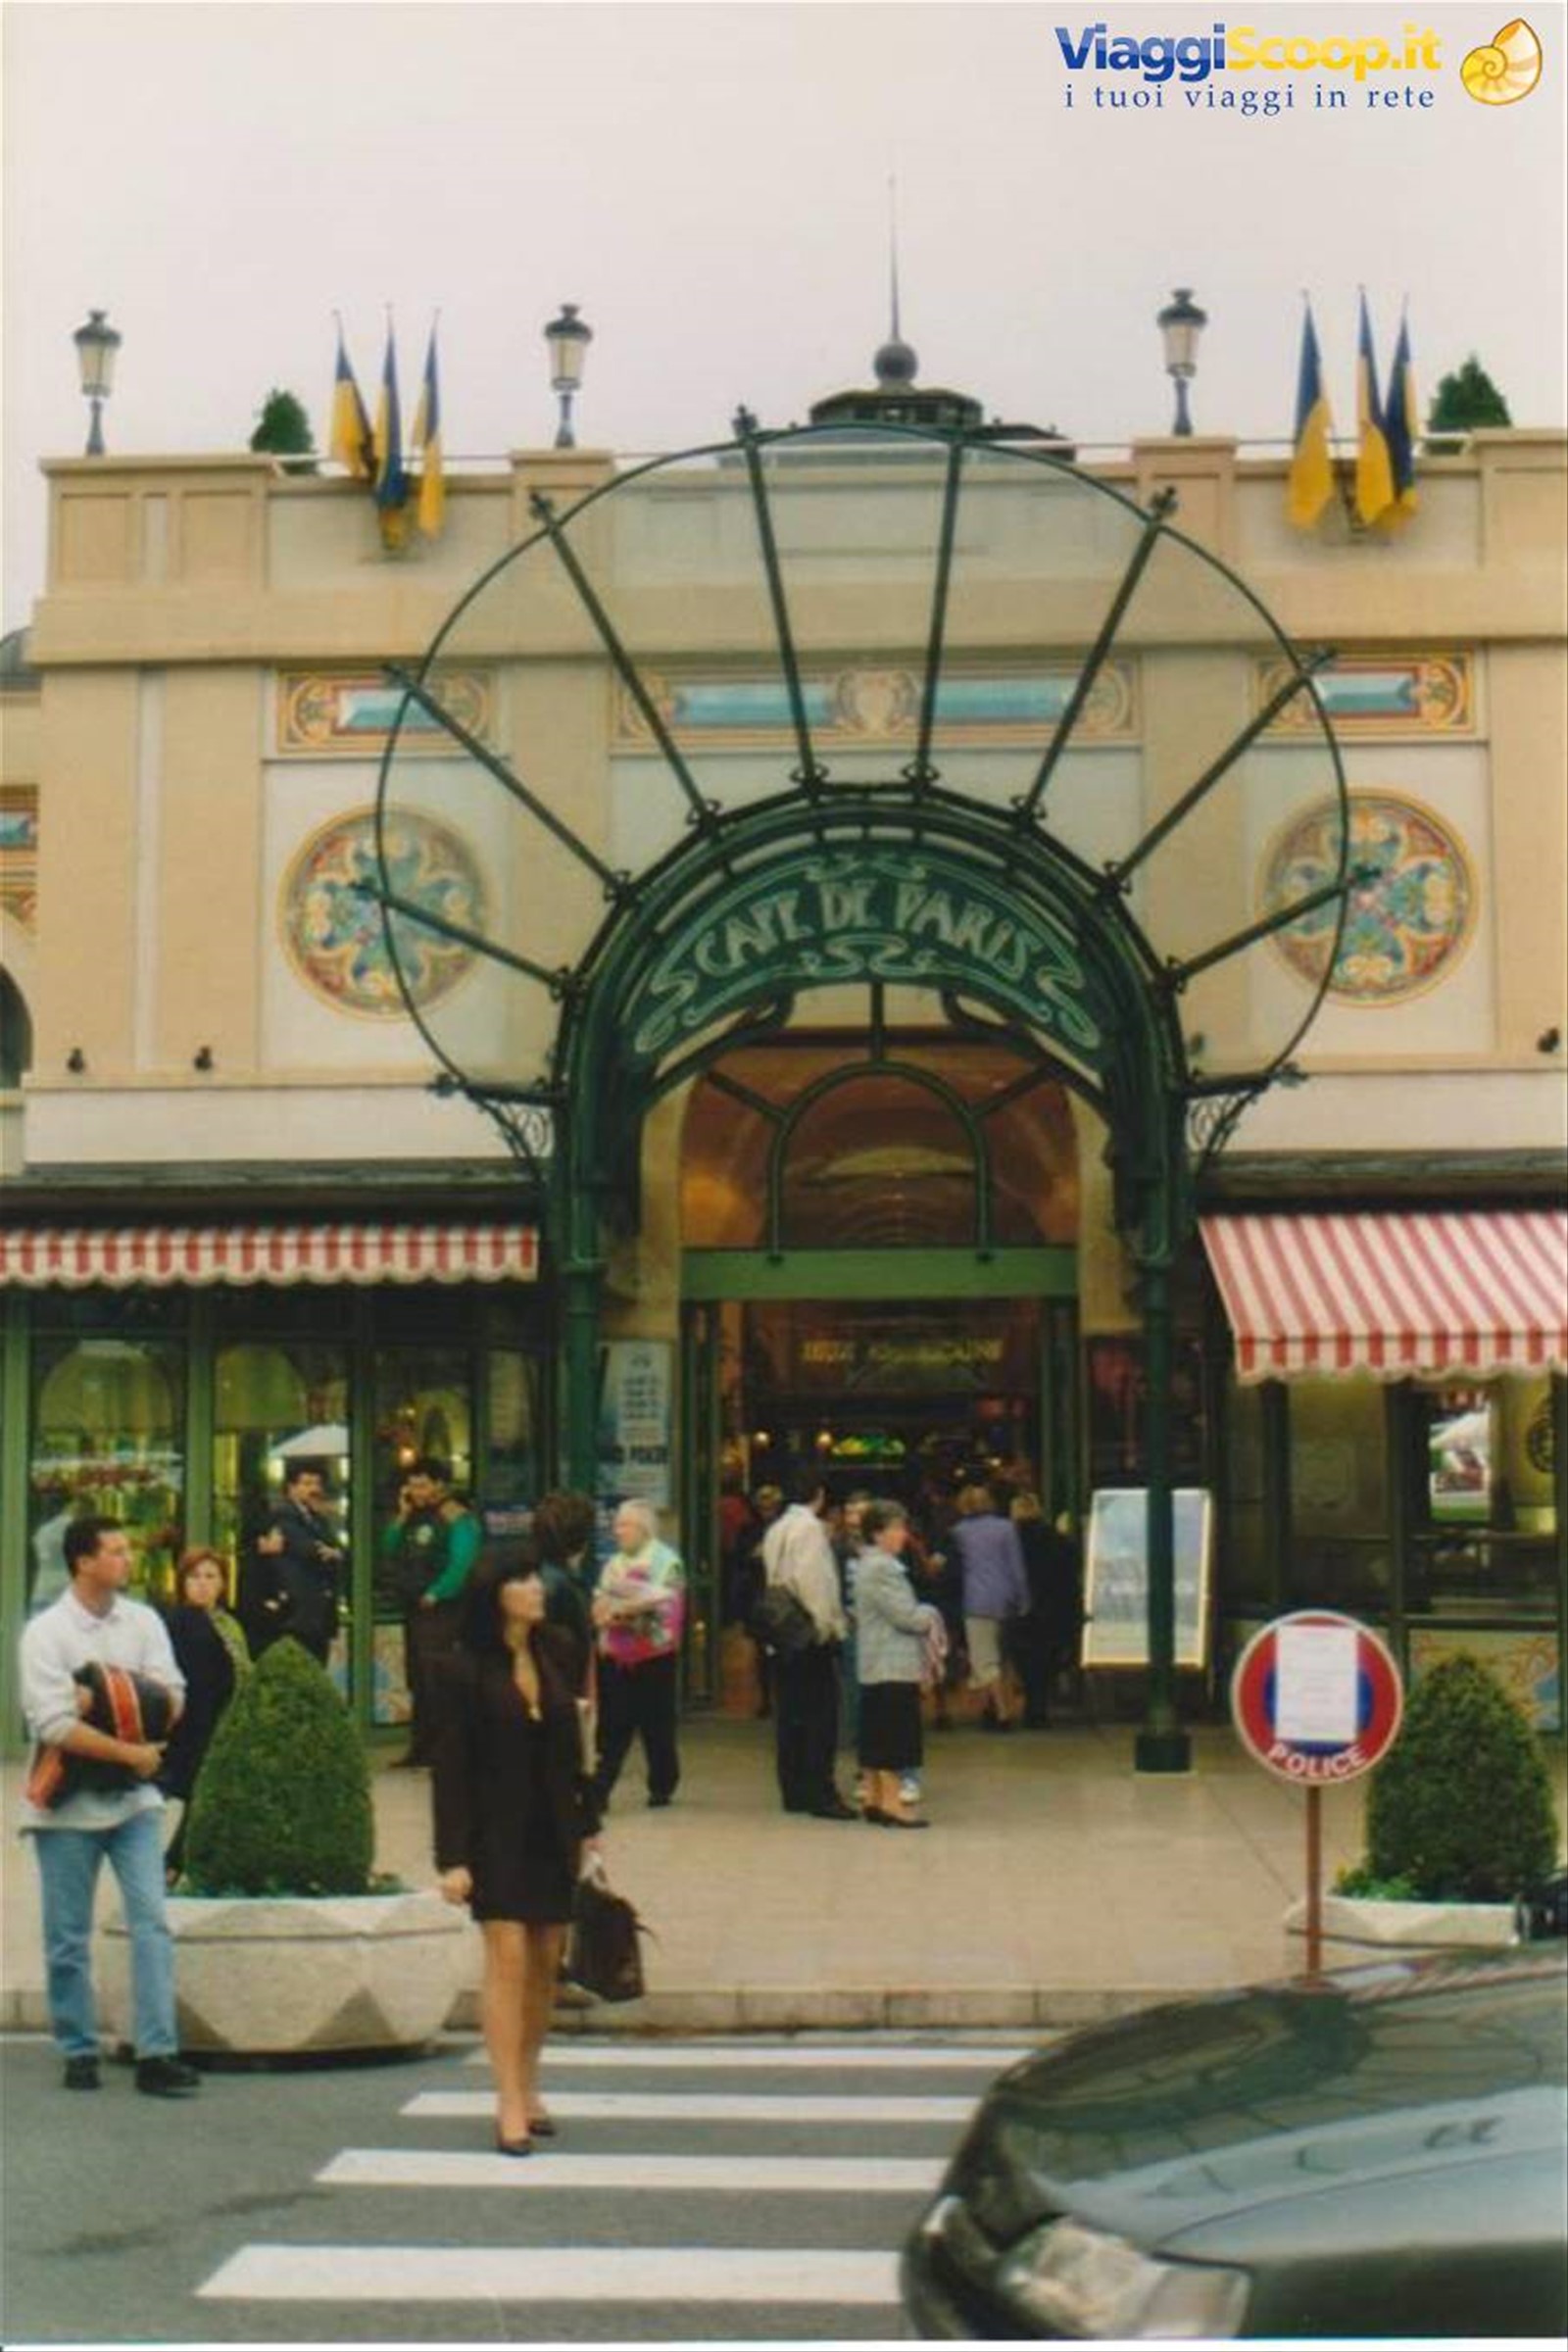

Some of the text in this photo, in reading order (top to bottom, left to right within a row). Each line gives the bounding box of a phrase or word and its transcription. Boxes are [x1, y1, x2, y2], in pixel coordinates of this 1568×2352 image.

[819, 879, 879, 930] DE
[896, 883, 1043, 981] PARIS
[1269, 1742, 1367, 1777] POLICE
